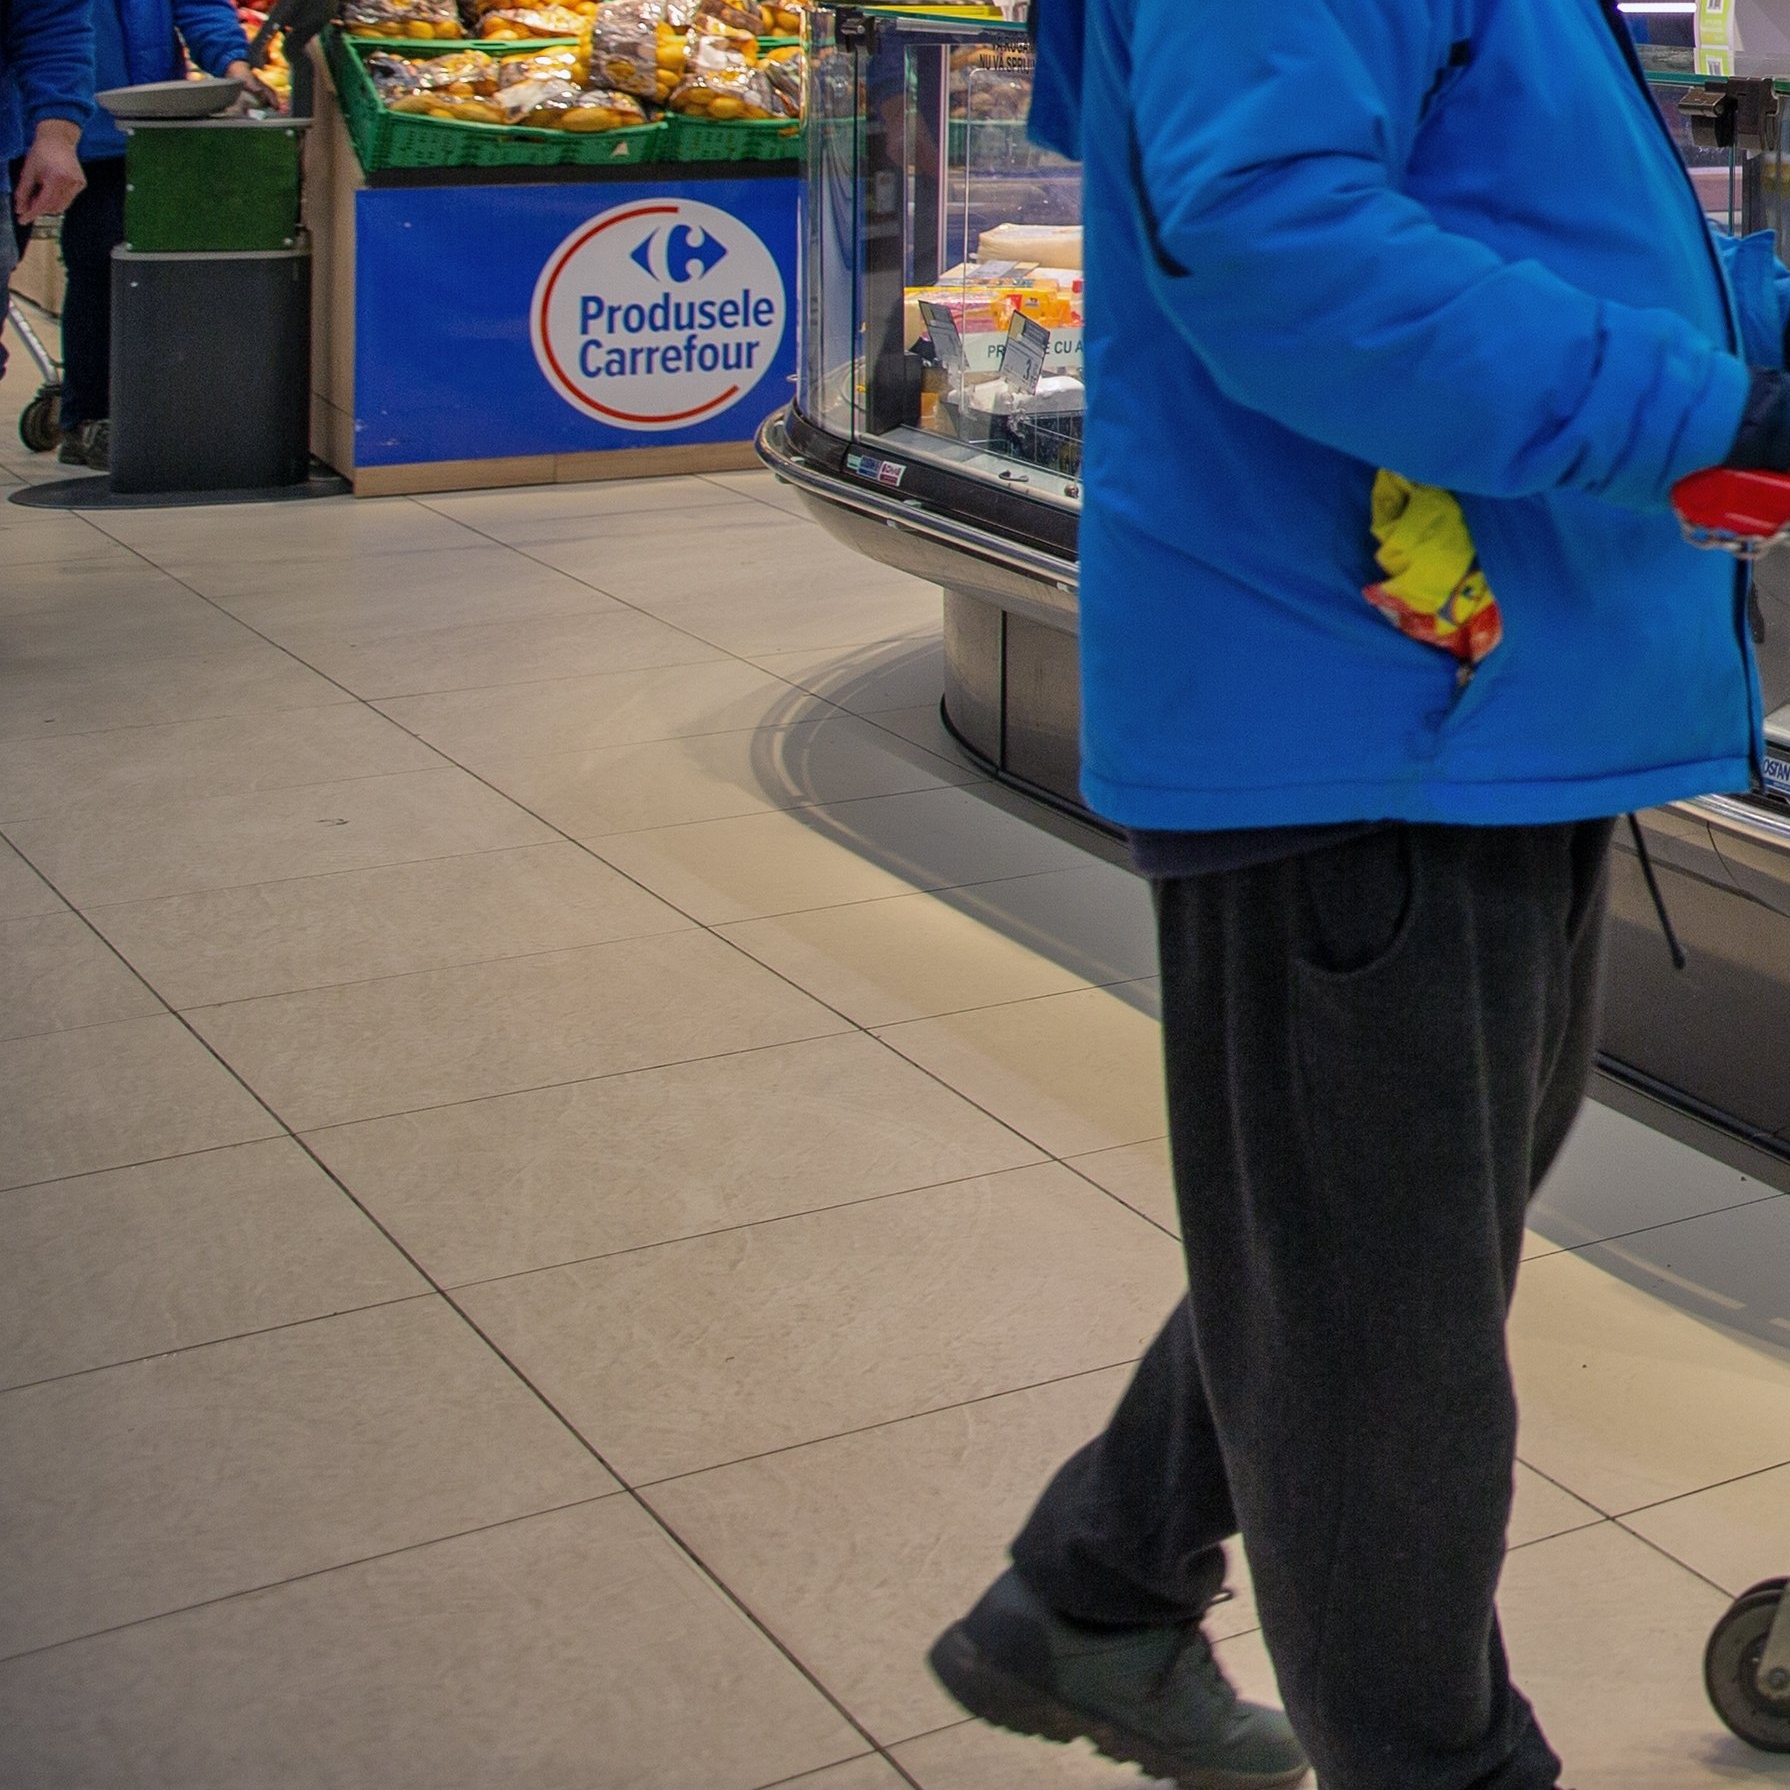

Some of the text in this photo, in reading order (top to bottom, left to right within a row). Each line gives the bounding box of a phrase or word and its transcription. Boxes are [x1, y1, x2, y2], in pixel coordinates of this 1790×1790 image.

[578, 288, 776, 337] Produsele
[578, 333, 760, 379] Carrefour
[1053, 340, 1073, 355] CU
